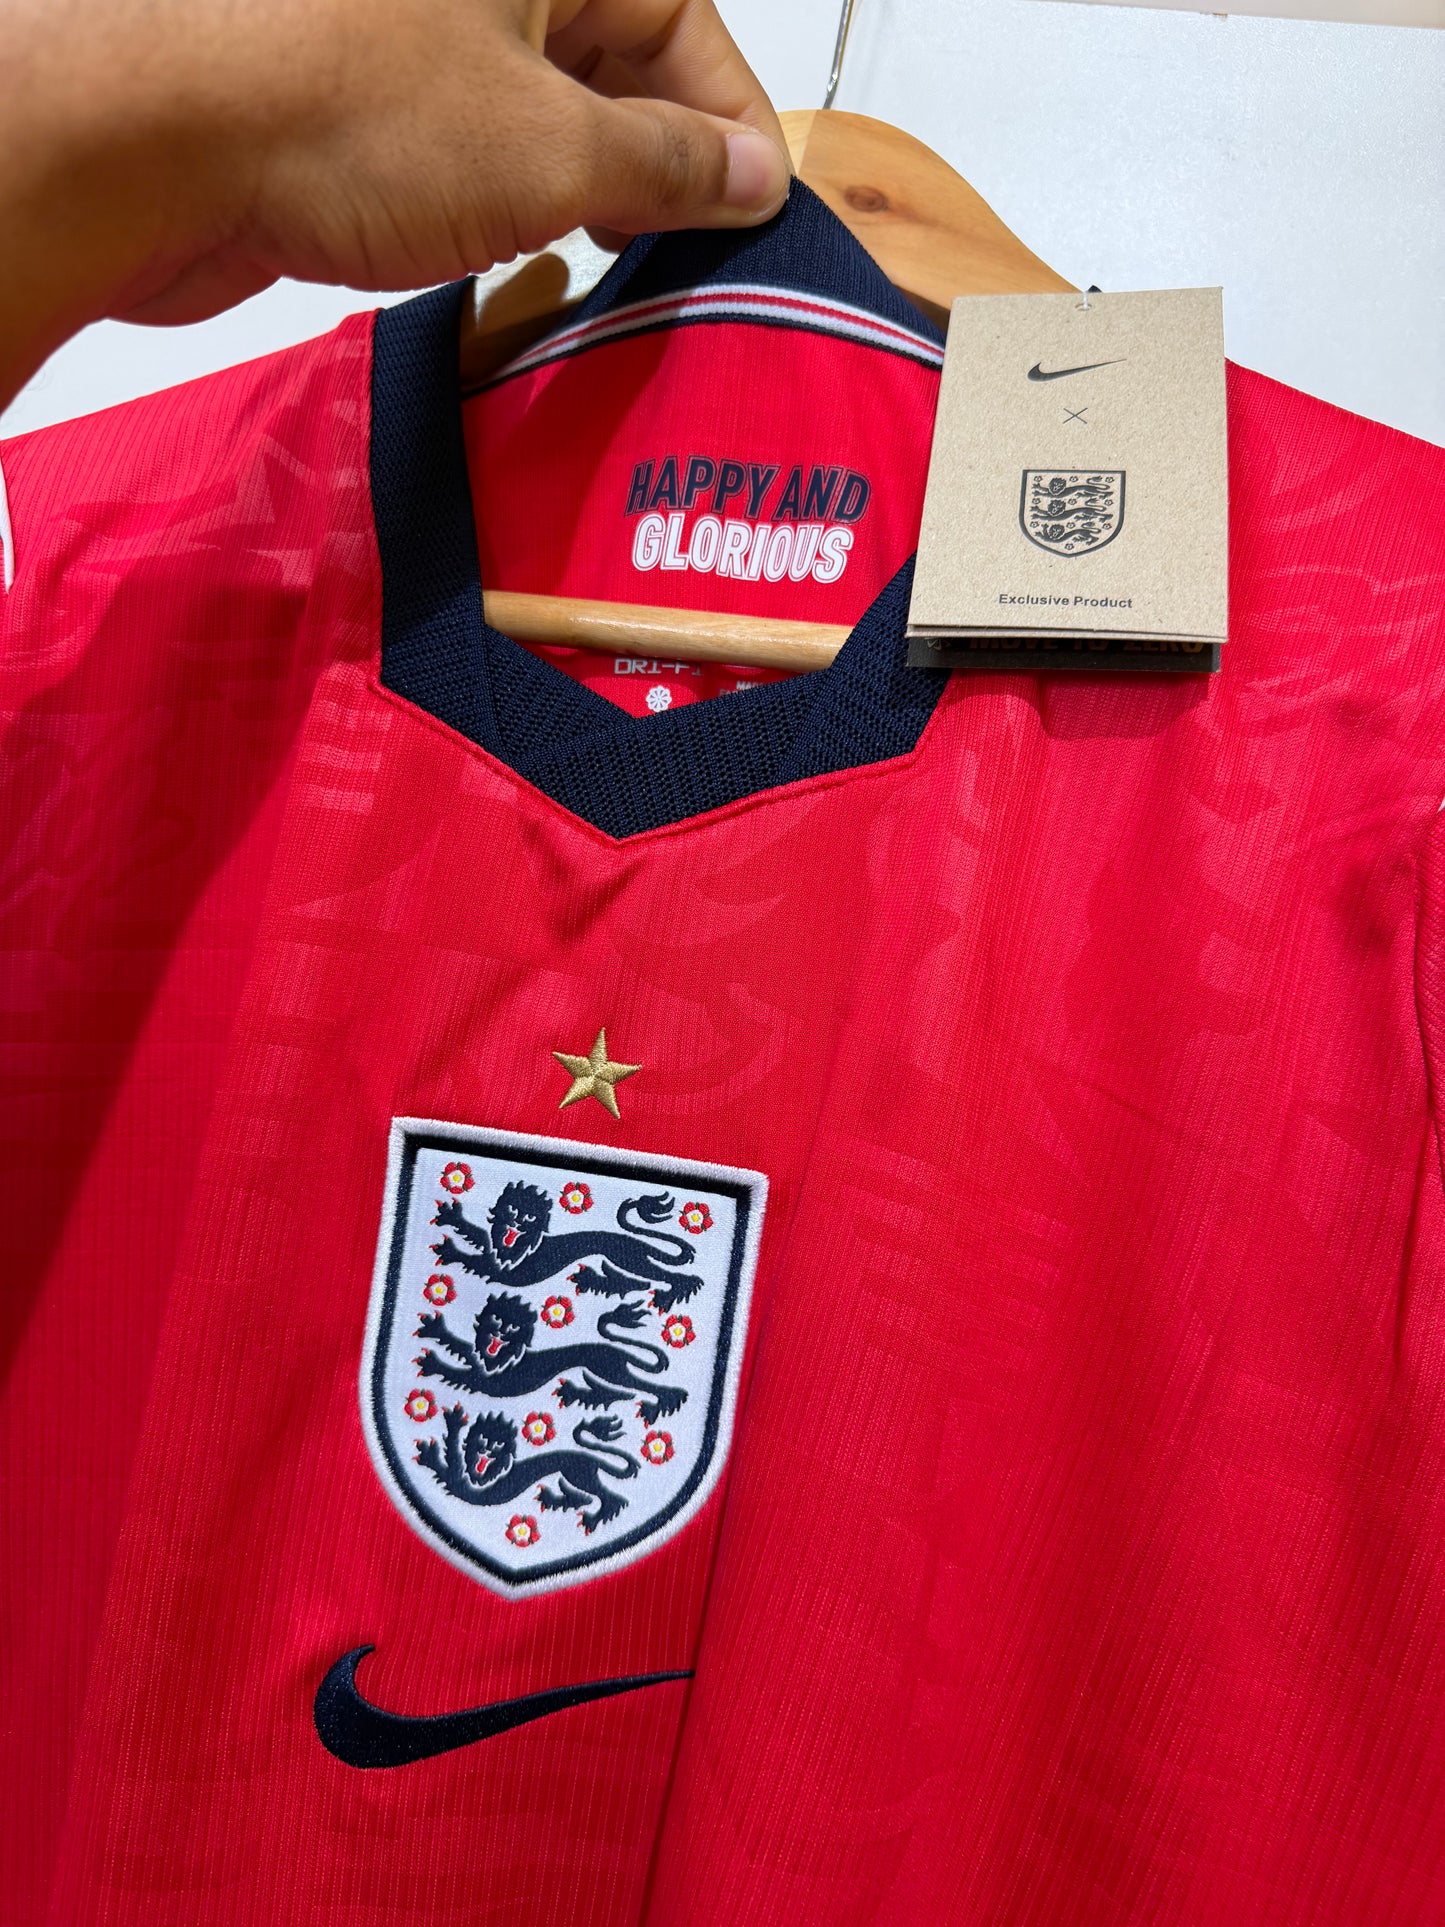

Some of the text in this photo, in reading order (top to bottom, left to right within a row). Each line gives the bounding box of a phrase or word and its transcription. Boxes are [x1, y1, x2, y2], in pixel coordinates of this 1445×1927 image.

[624, 455, 871, 524] HAPPY AND
[632, 512, 854, 584] GLORIOUS
[999, 594, 1133, 608] Exclusive Product
